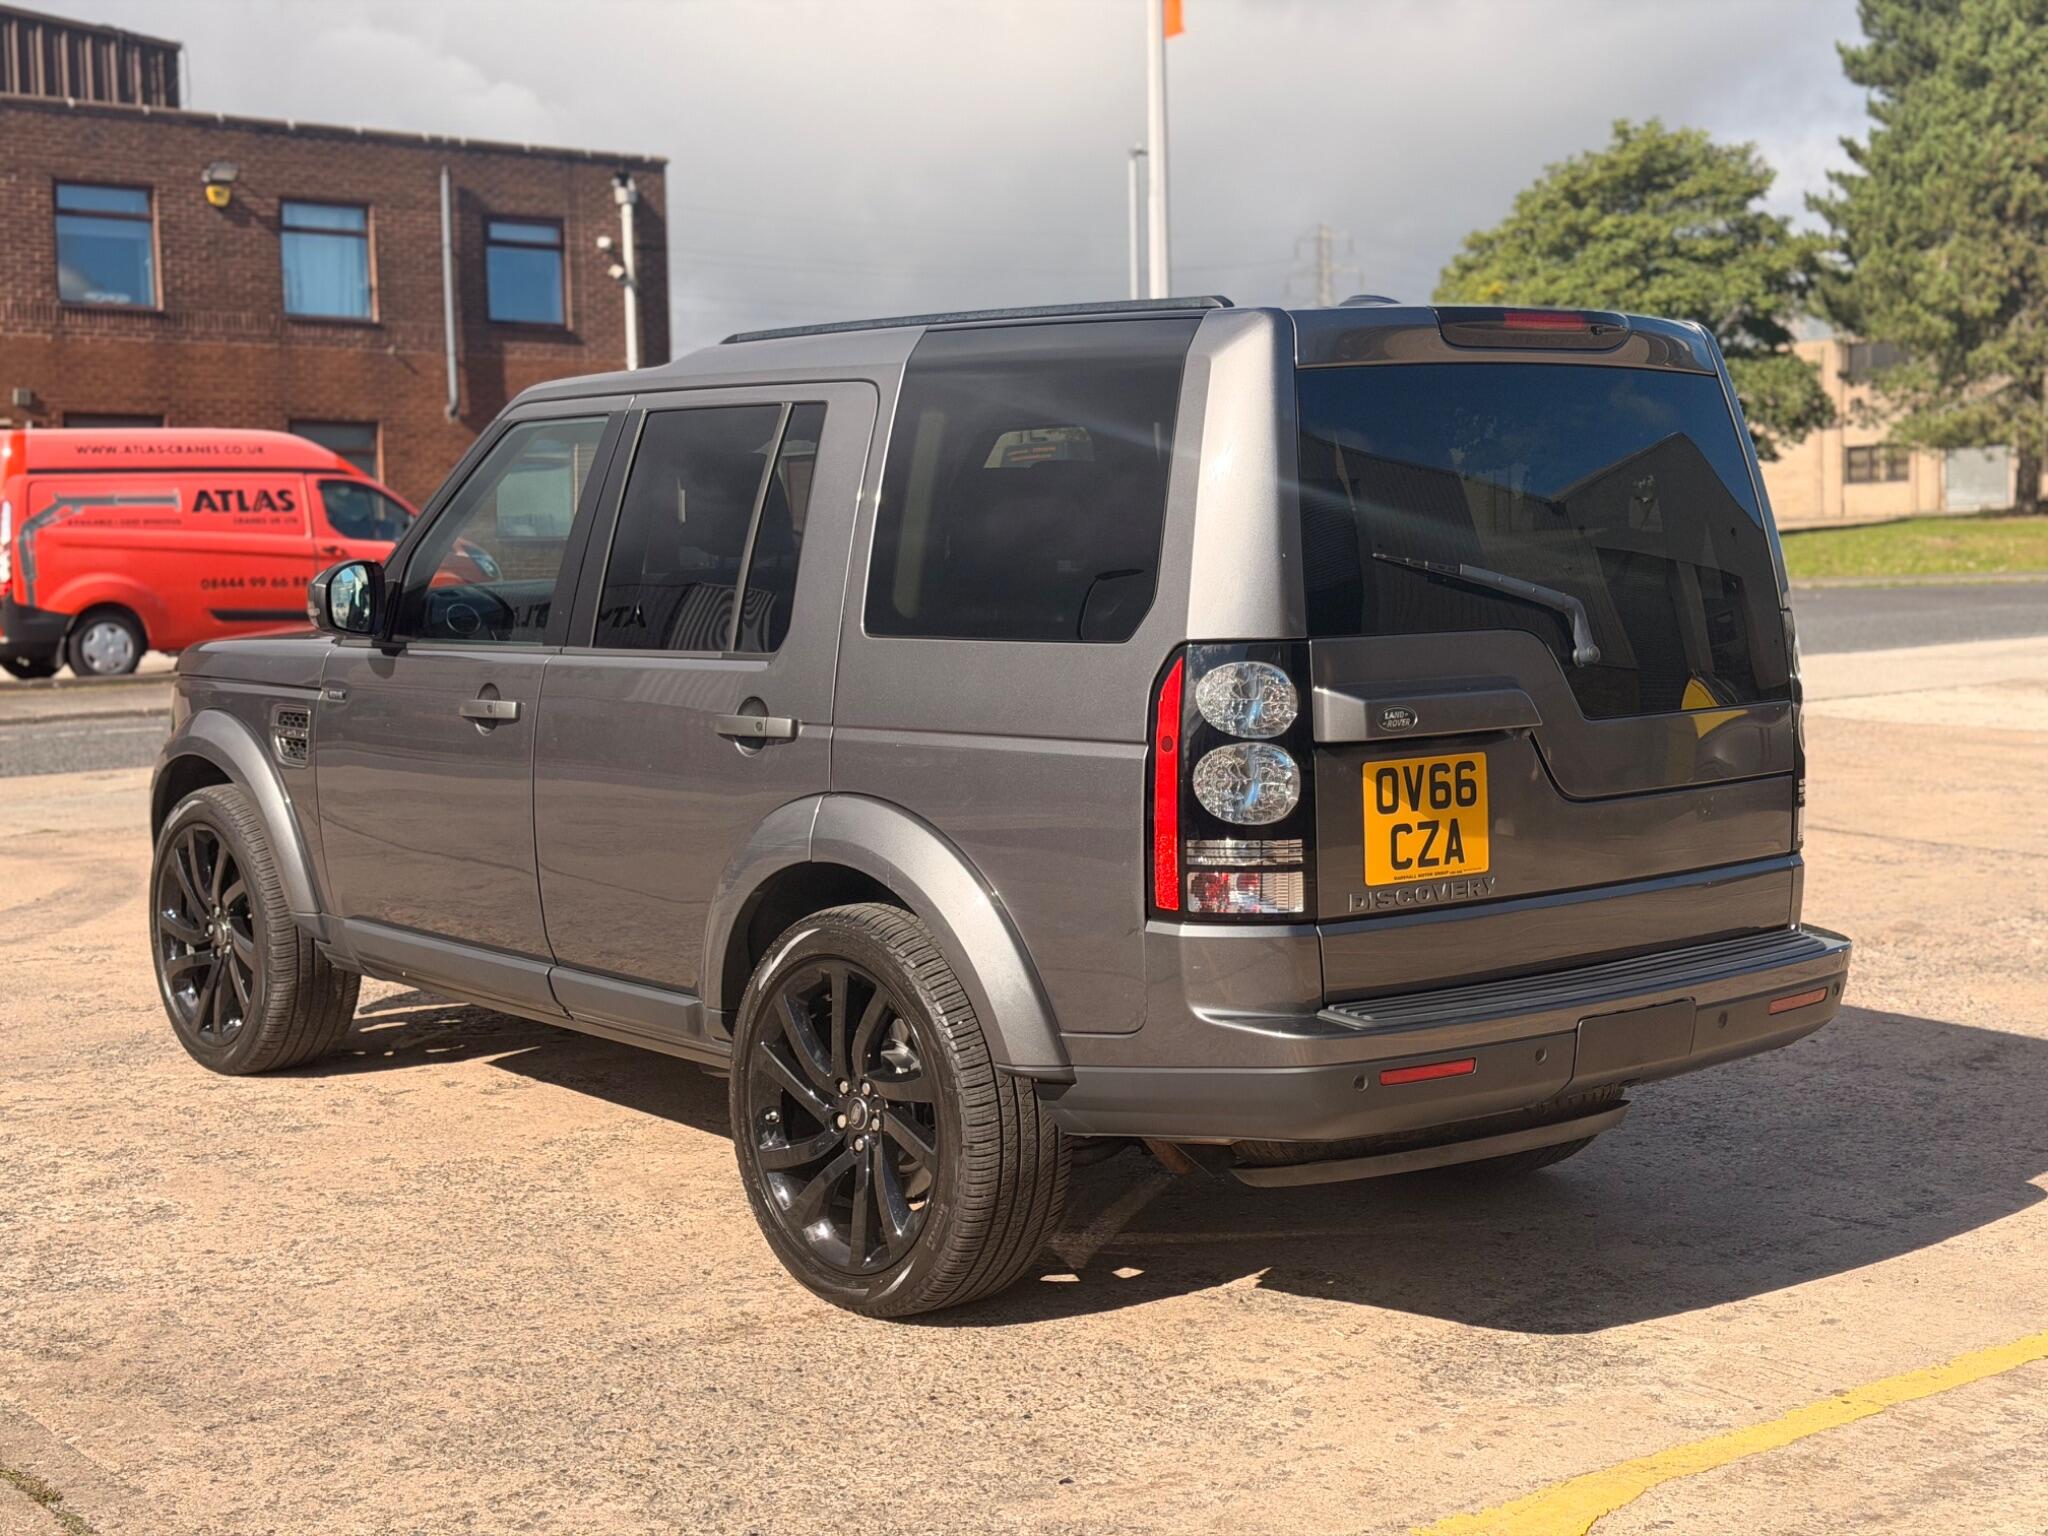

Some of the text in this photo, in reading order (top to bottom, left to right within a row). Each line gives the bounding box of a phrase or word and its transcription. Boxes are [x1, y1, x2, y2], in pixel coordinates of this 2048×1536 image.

[193, 489, 296, 512] ATLAS
[1384, 711, 1405, 720] LAND
[1386, 717, 1411, 728] ROVER
[1375, 760, 1477, 815] OV66
[1390, 818, 1465, 871] CZA
[1348, 876, 1496, 913] DISCOVERY
